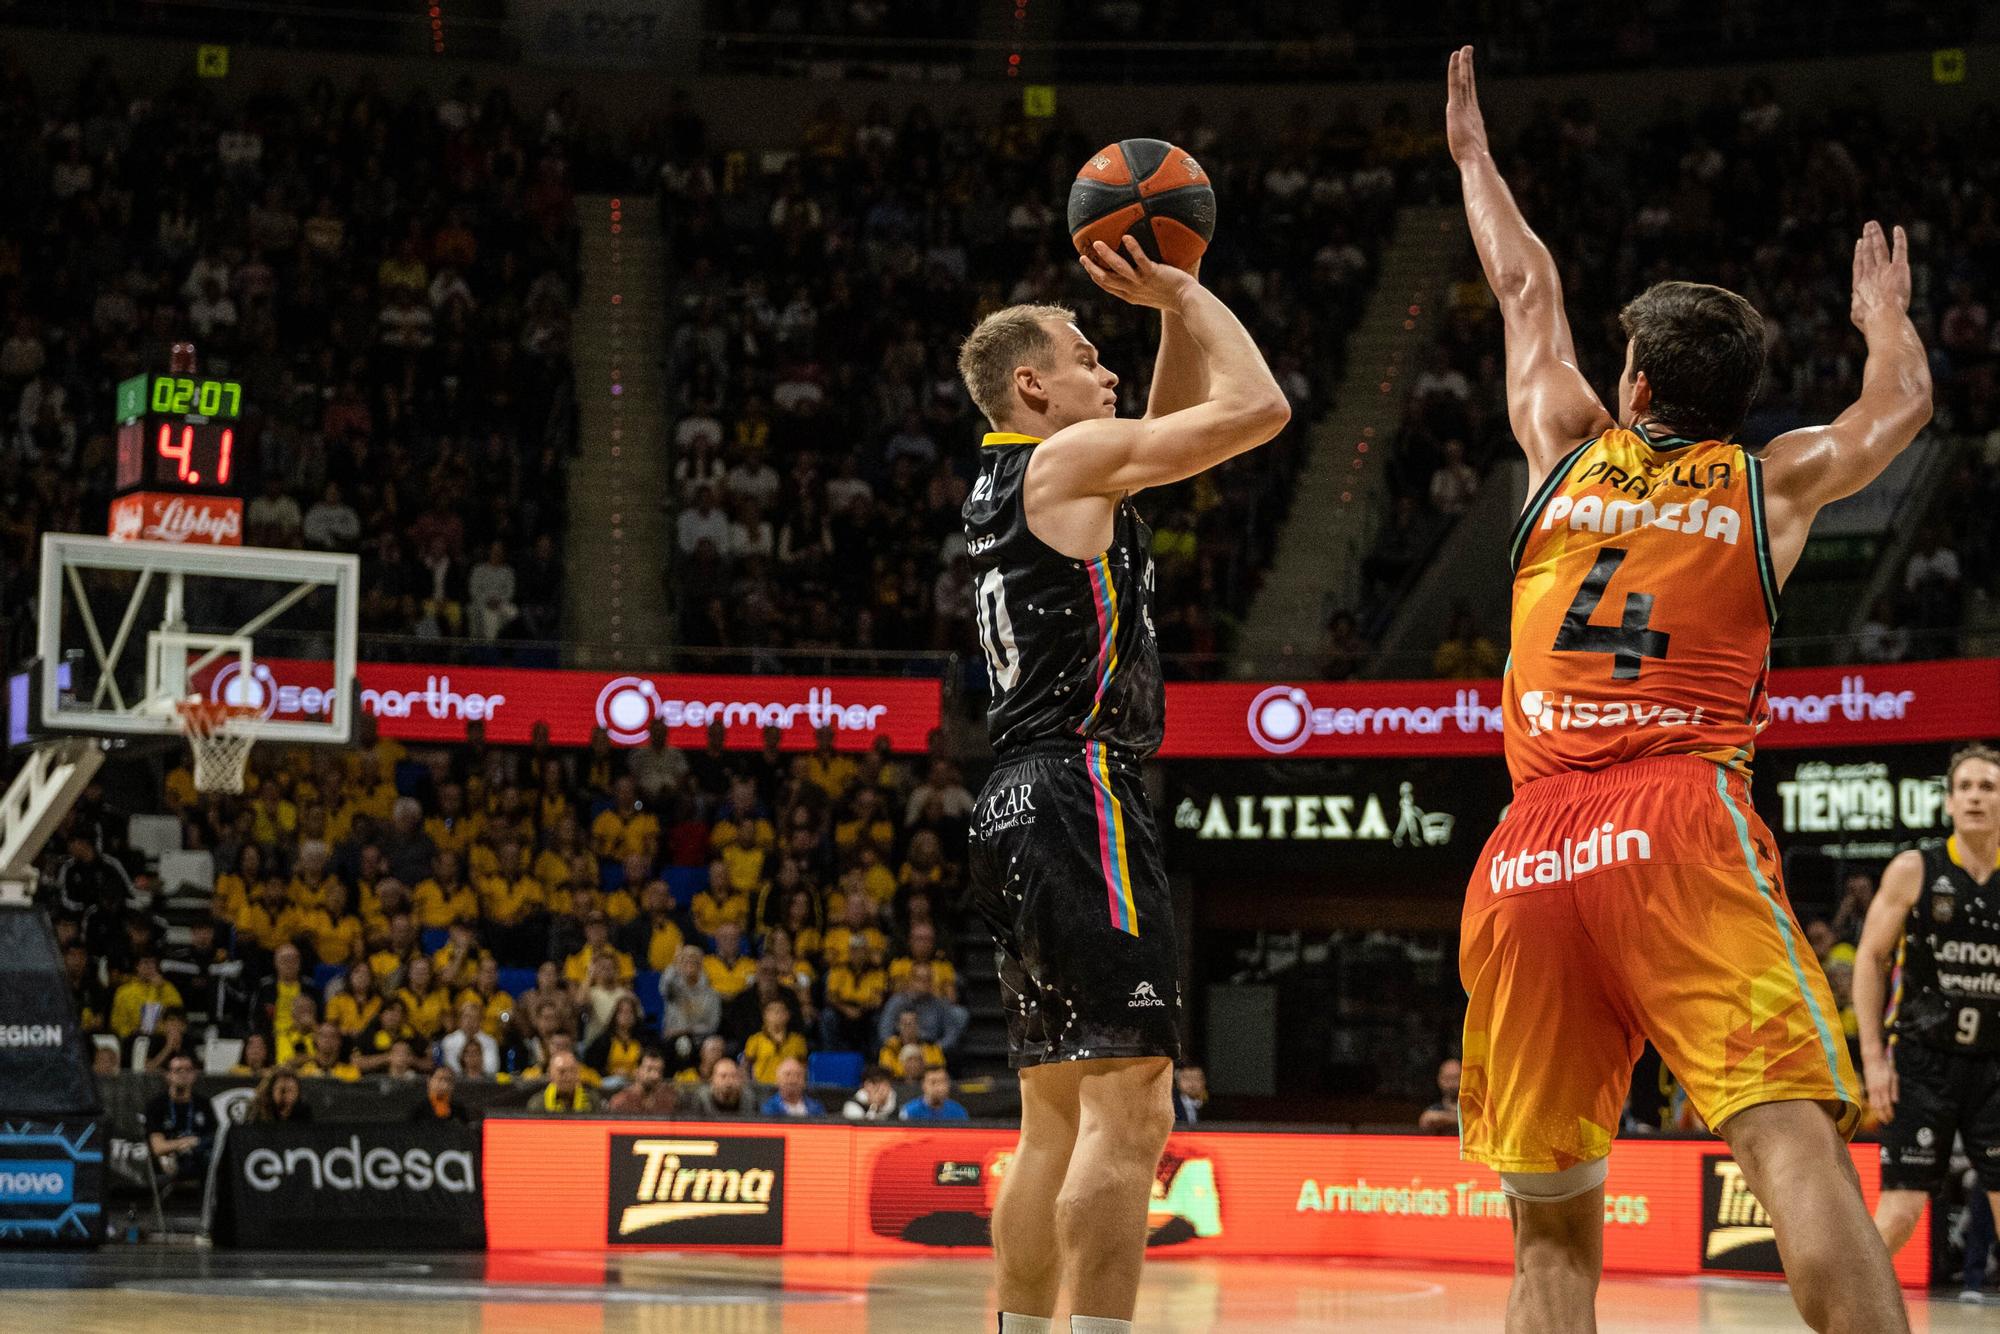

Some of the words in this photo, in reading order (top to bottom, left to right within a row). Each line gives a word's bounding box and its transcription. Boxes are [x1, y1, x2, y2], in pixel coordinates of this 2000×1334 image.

[1552, 546, 1671, 681] 4
[1020, 813, 1036, 825] Car
[1955, 1006, 1981, 1045] 9
[243, 1133, 476, 1193] endesa
[632, 1139, 775, 1202] Tirma
[1603, 1192, 1651, 1226] cos
